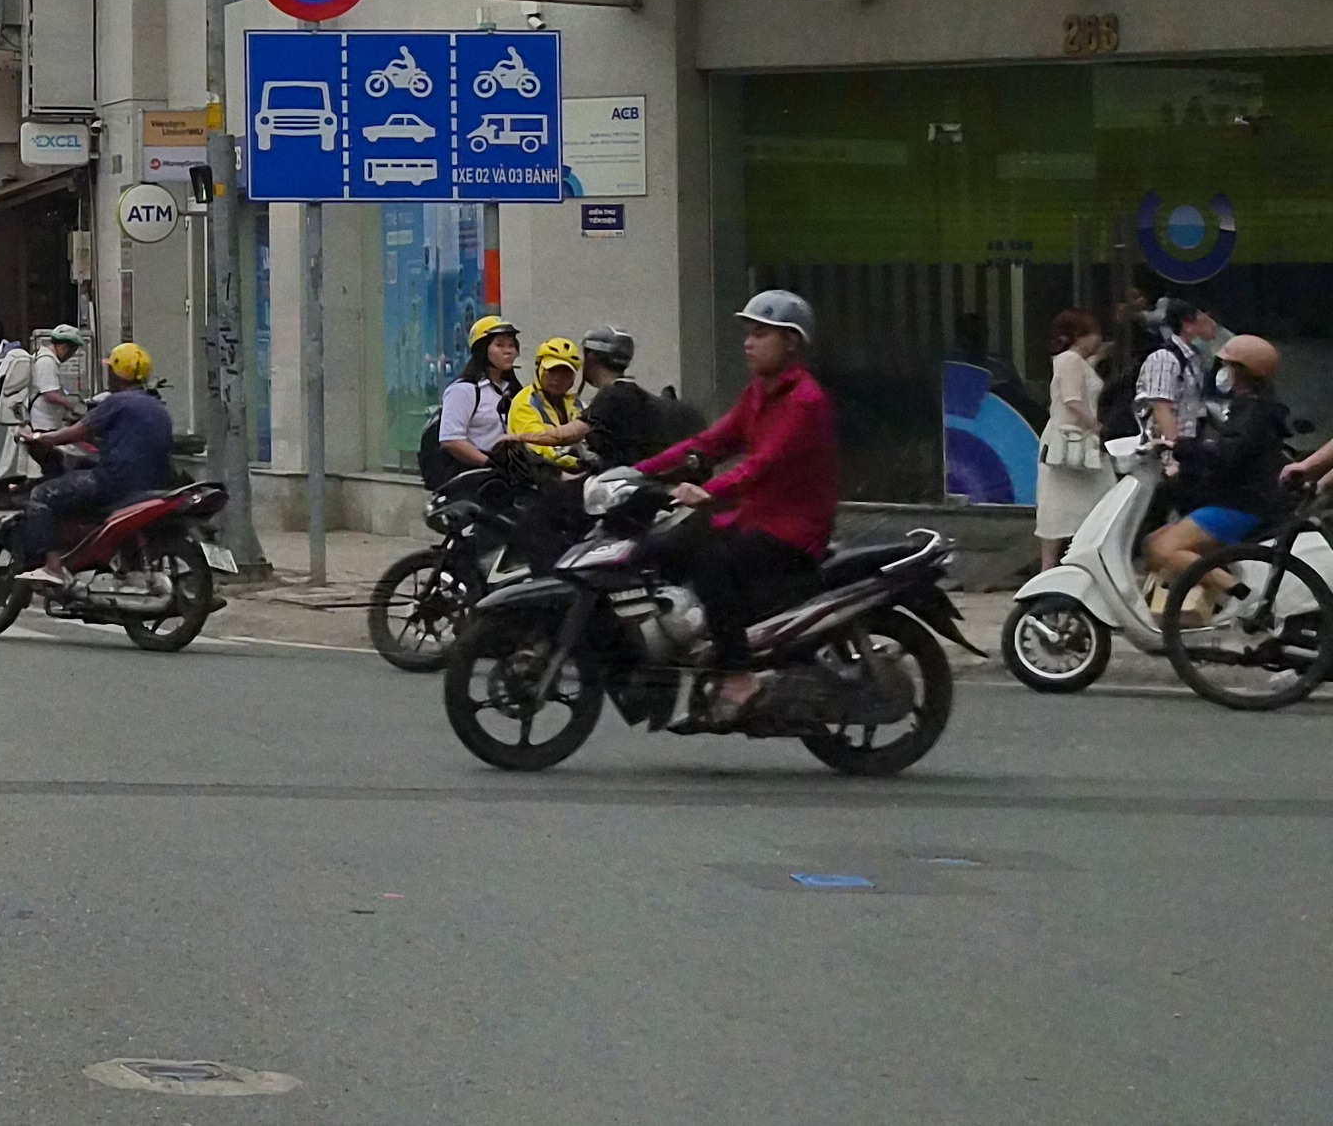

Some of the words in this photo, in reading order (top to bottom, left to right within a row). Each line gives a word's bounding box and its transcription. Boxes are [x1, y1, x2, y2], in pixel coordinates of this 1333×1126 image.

[611, 106, 640, 121] ACB
[458, 167, 474, 184] XE
[475, 167, 490, 184] 02
[492, 163, 507, 184] VÀ
[508, 167, 523, 184] 03
[525, 163, 559, 184] BÁNH
[127, 204, 173, 223] ATM
